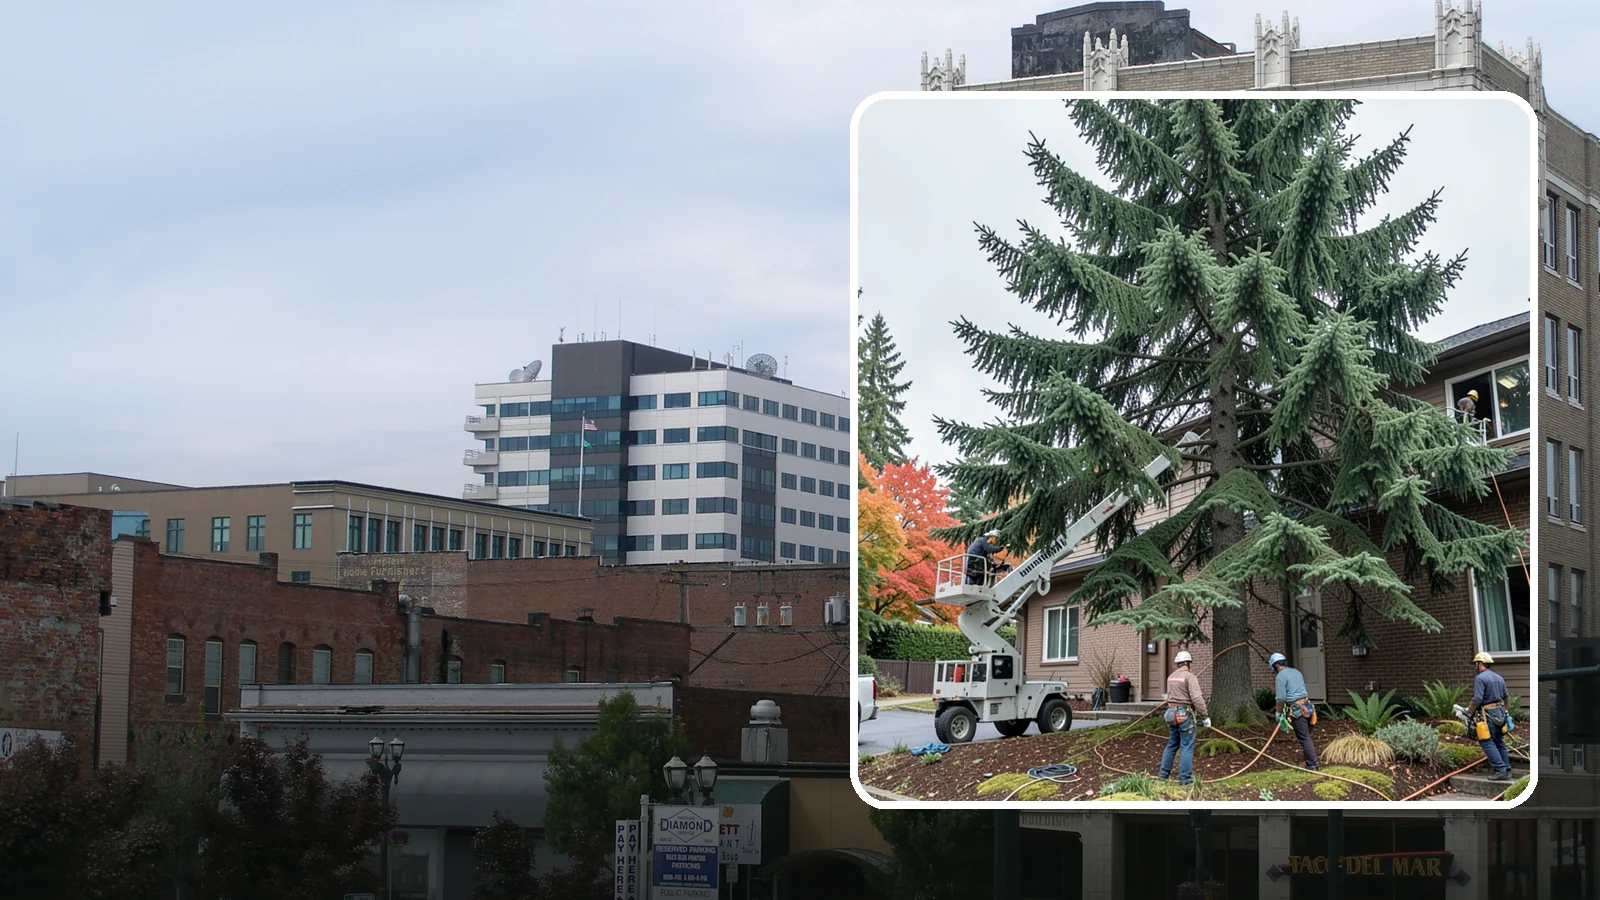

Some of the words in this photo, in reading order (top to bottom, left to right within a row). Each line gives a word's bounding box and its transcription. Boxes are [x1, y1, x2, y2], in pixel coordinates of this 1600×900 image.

[343, 568, 367, 577] Home
[370, 566, 427, 576] Furnishers
[660, 818, 713, 833] DIAMOND
[1022, 815, 1070, 828] BUILDING
[617, 825, 625, 852] PAY
[628, 824, 636, 852] PAY
[656, 845, 688, 853] RESERVED
[689, 846, 716, 854] PARKING
[721, 851, 739, 863] Soup
[671, 862, 701, 870] PATRONS
[1290, 855, 1329, 874] TAC
[1346, 856, 1385, 875] DEL
[1392, 857, 1443, 877] MAR
[617, 856, 625, 893] HERE
[628, 856, 636, 893] HERE
[661, 889, 682, 897] PUBLIC
[684, 889, 710, 898] PARKING
